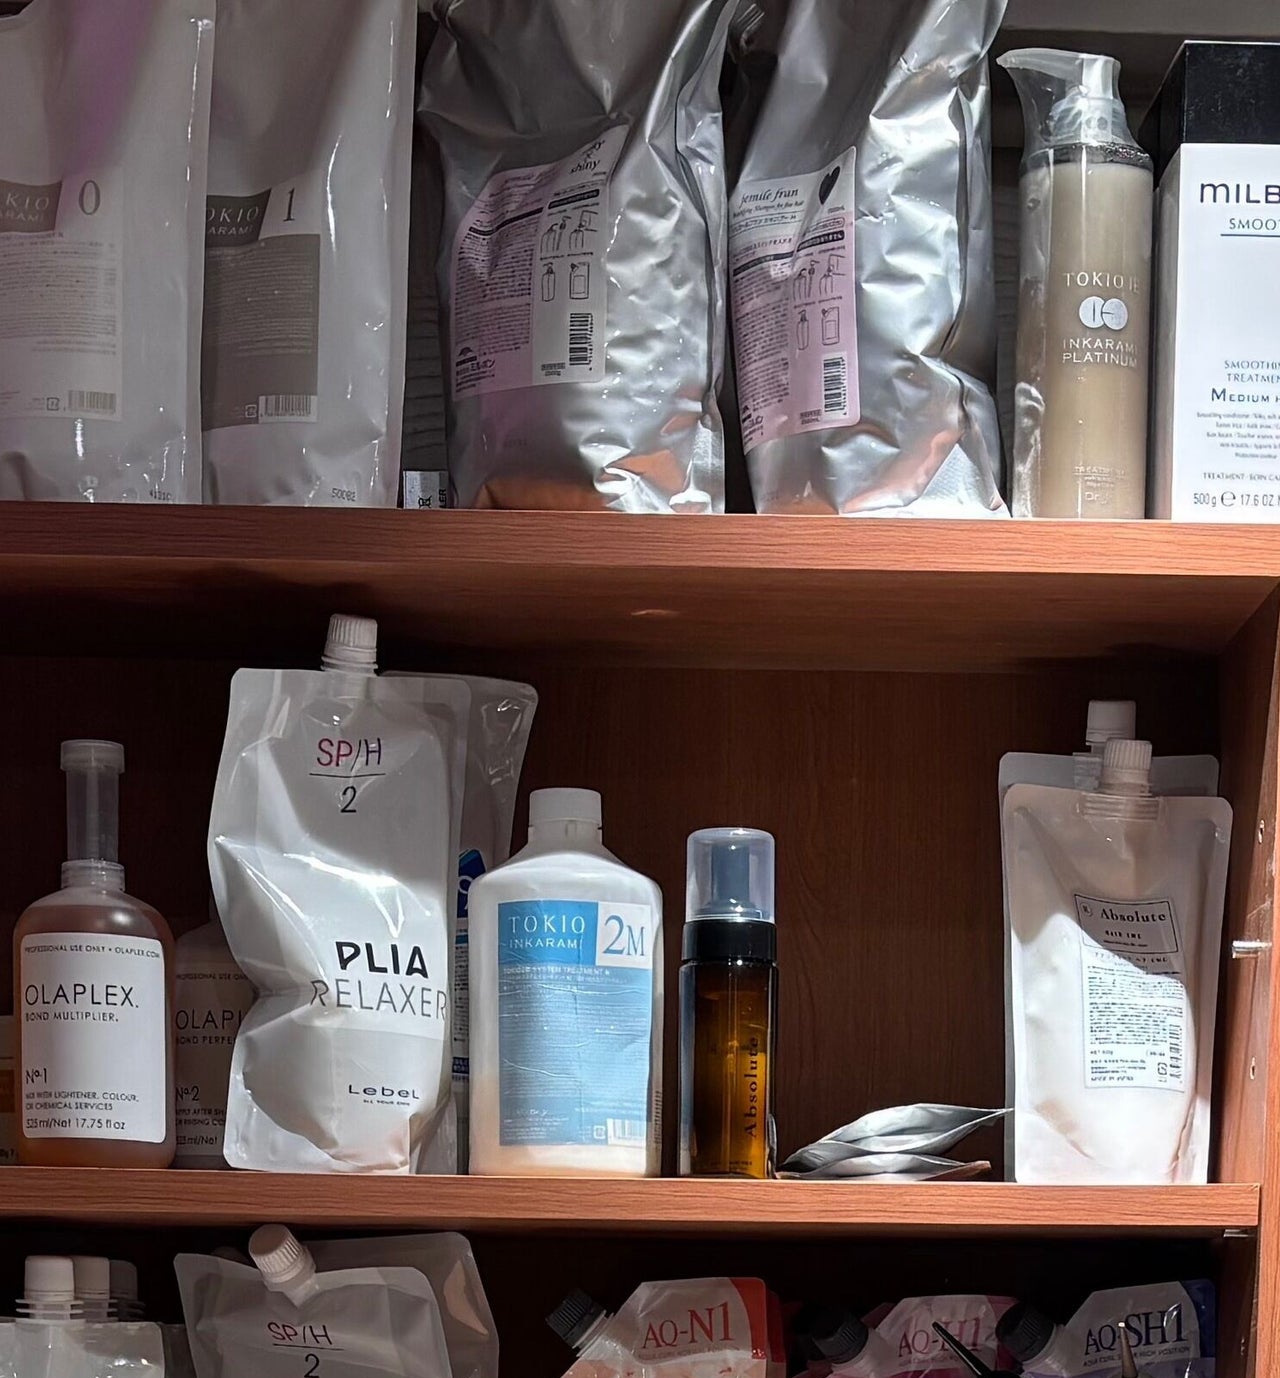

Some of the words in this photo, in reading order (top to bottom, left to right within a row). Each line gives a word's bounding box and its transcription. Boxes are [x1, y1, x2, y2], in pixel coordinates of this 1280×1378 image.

[78, 179, 101, 216] 0
[282, 188, 296, 222] 1
[1063, 271, 1124, 289] TOKIO
[1063, 338, 1138, 354] INKARAMI
[1062, 352, 1137, 368] PLATINUM
[316, 737, 382, 769] SP/H
[340, 785, 357, 814] 2
[508, 915, 585, 935] TOKIO
[1100, 908, 1167, 923] Absolute
[335, 941, 429, 978] PLIA
[310, 978, 447, 1021] RELAXER
[176, 1010, 242, 1030] OLAP
[744, 1036, 759, 1138] Absolute
[303, 1353, 321, 1378] 2
